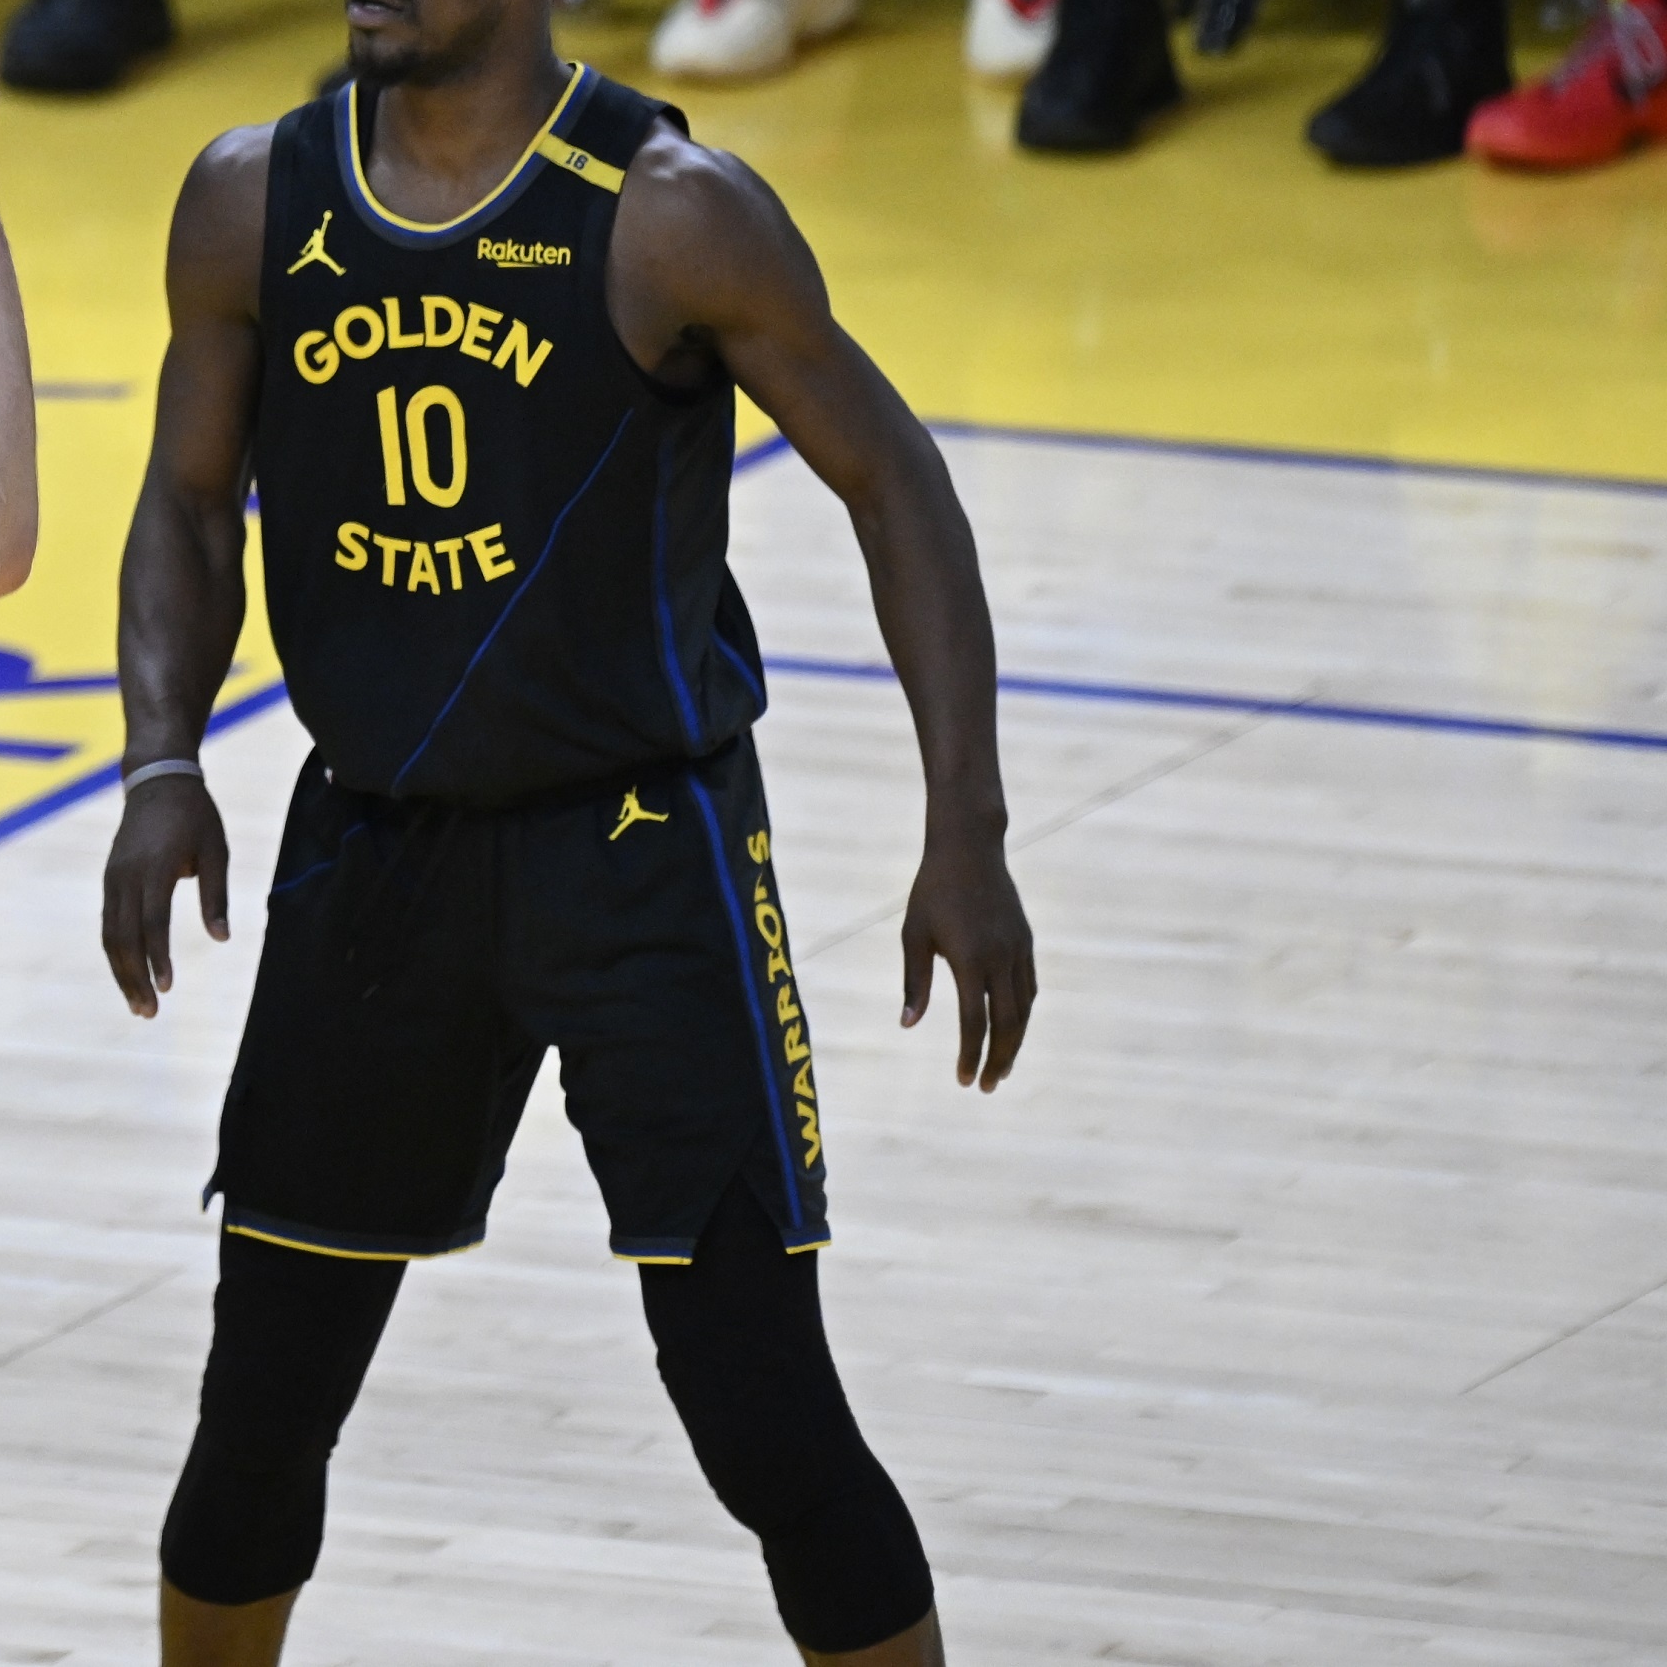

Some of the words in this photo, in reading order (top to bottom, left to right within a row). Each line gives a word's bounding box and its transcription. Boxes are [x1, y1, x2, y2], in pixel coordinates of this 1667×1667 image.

[477, 237, 571, 268] Rakuten
[293, 295, 554, 388] GOLDEN
[376, 384, 468, 508] 10
[334, 521, 516, 596] STATE
